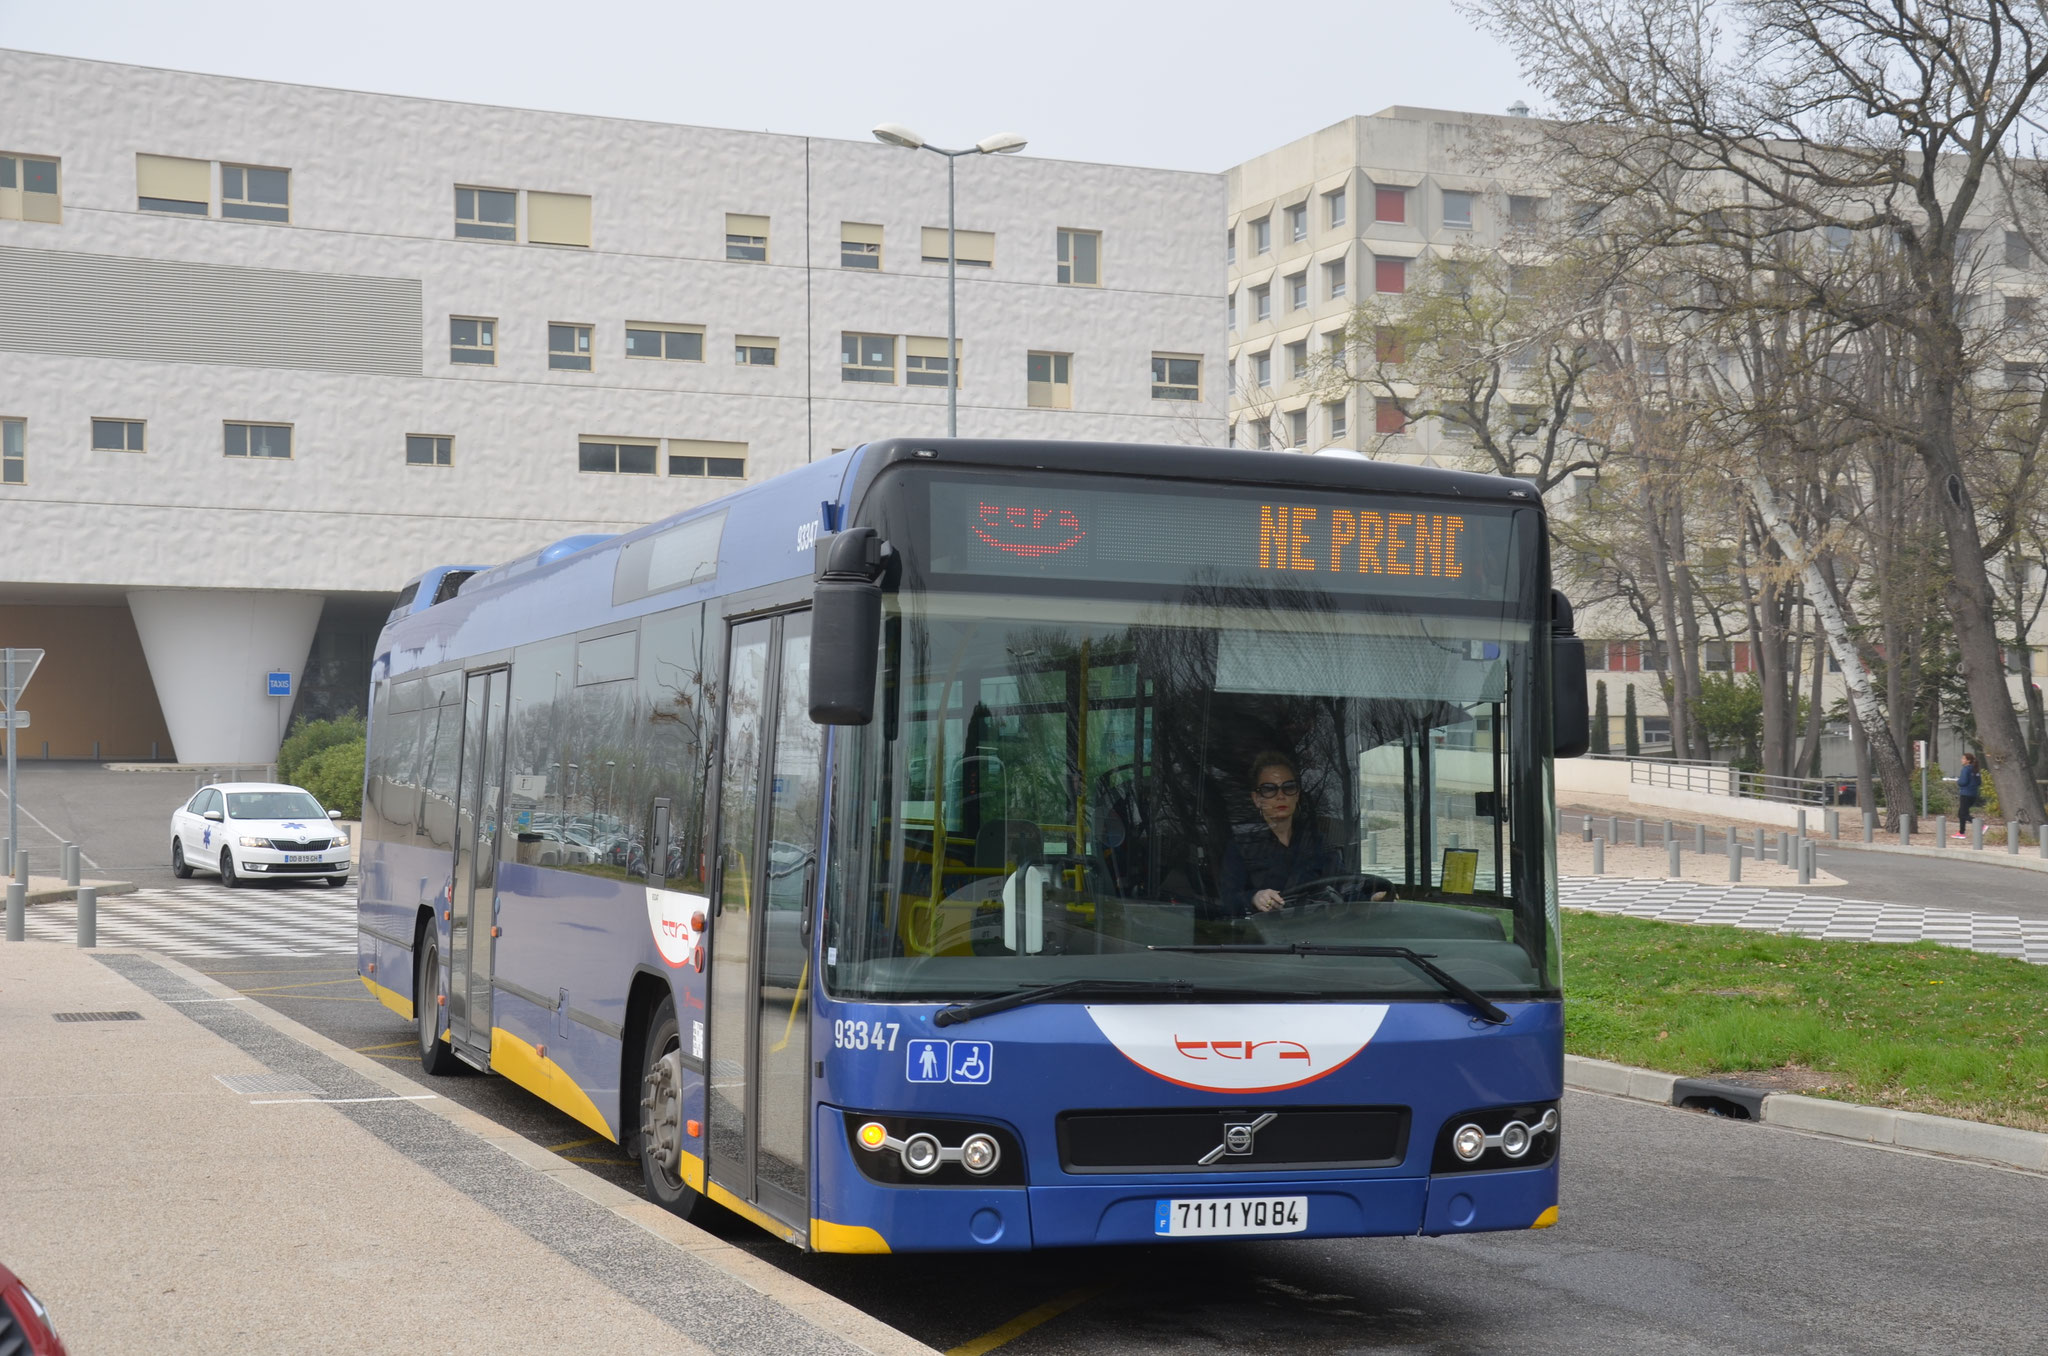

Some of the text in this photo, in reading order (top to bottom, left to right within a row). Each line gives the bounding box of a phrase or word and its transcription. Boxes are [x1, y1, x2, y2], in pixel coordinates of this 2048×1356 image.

[797, 520, 818, 552] 93347
[1260, 505, 1317, 571] NE
[270, 680, 289, 688] TAXIS
[835, 1019, 900, 1052] 93347
[1160, 1219, 1167, 1229] F
